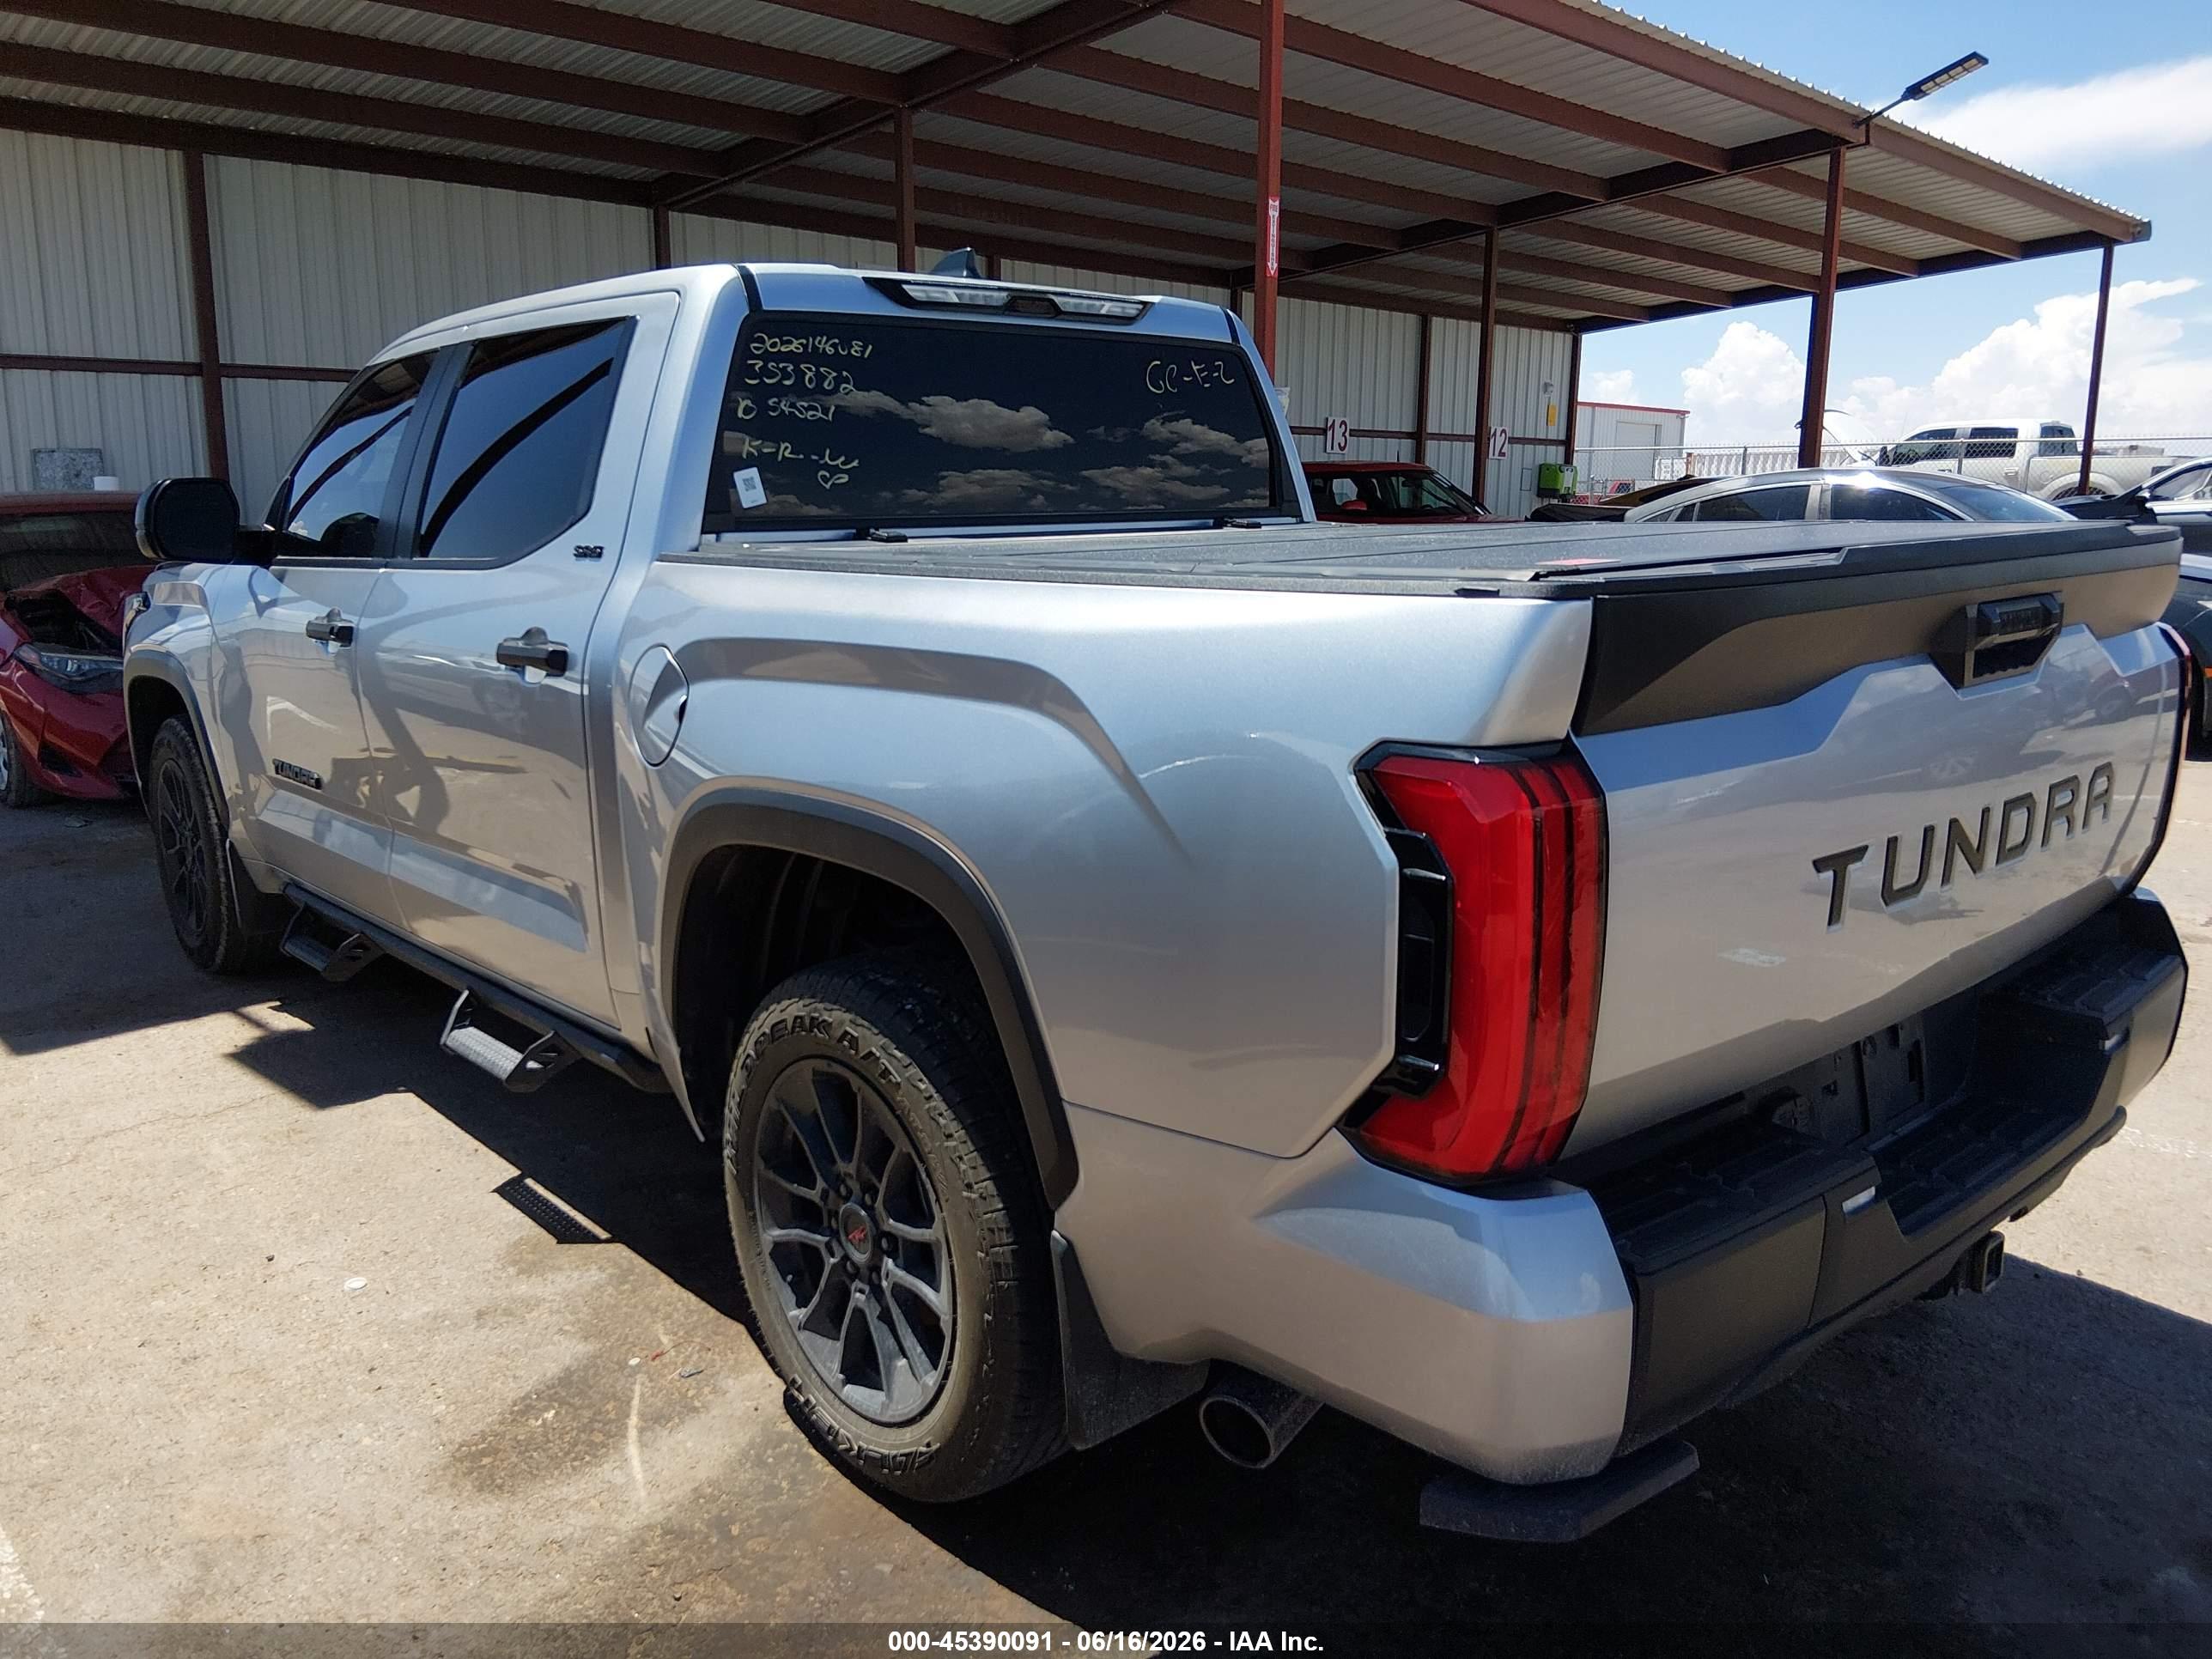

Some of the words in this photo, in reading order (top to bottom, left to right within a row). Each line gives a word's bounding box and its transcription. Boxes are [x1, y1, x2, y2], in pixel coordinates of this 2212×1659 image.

[1328, 419, 1348, 452] 13
[1491, 428, 1508, 458] 12
[1812, 762, 2115, 927] TUNDRA
